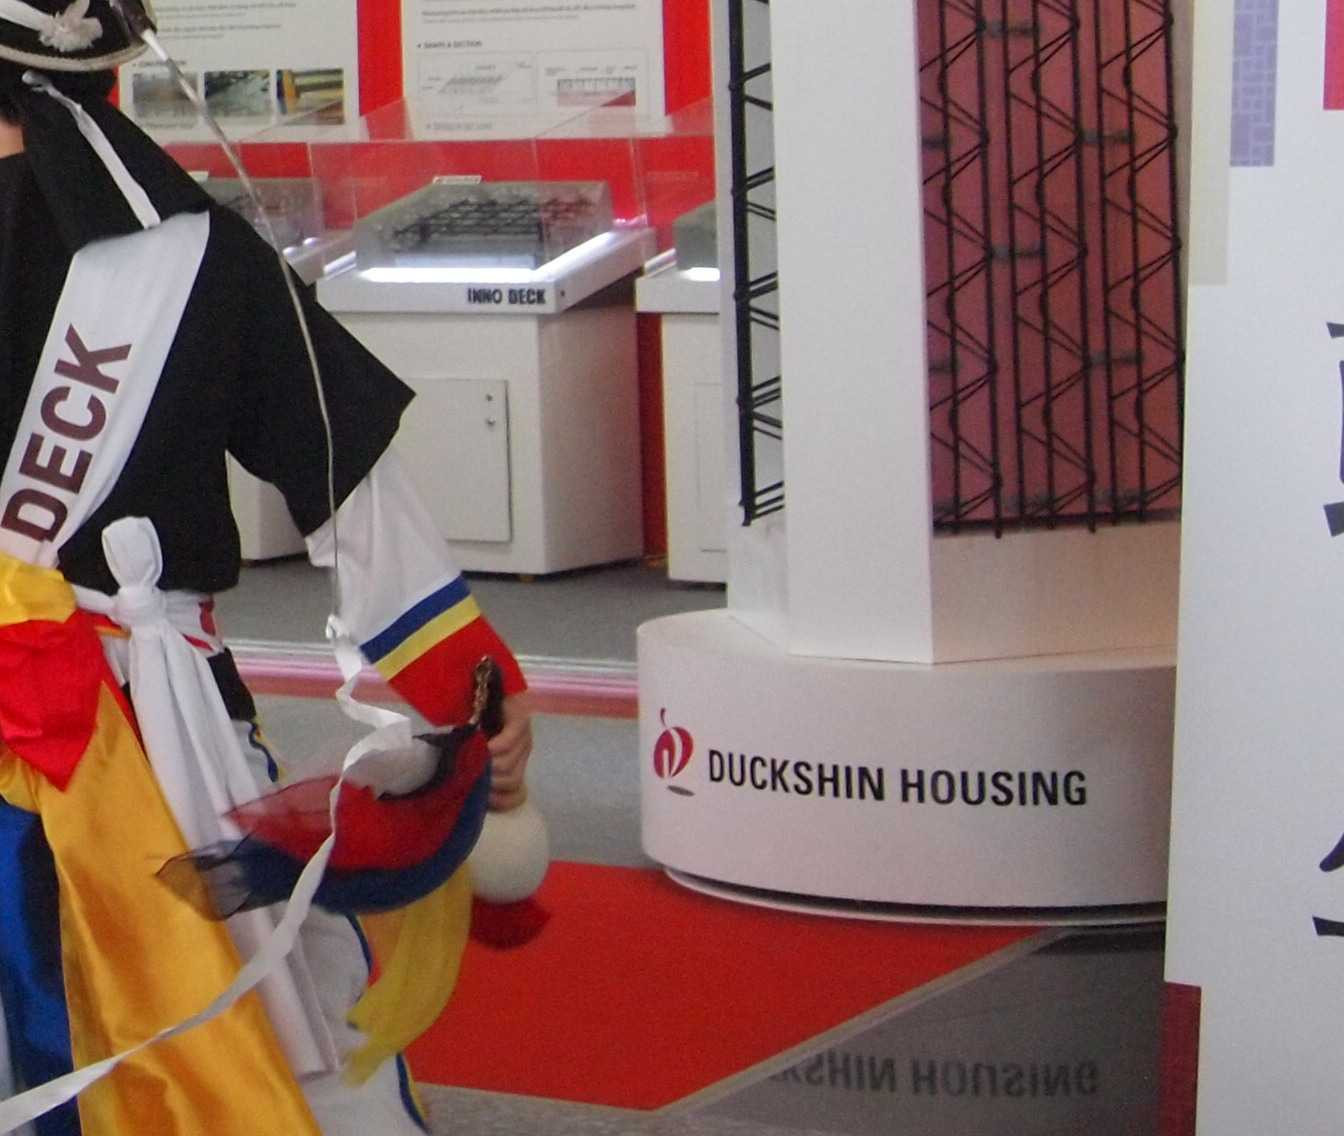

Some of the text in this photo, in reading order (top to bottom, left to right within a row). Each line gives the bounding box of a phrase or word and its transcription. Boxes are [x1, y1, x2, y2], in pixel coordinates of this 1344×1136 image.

[467, 287, 546, 305] INNO DECK
[0, 322, 133, 543] DECK
[708, 749, 1087, 806] DUCKSHIN HOUSING
